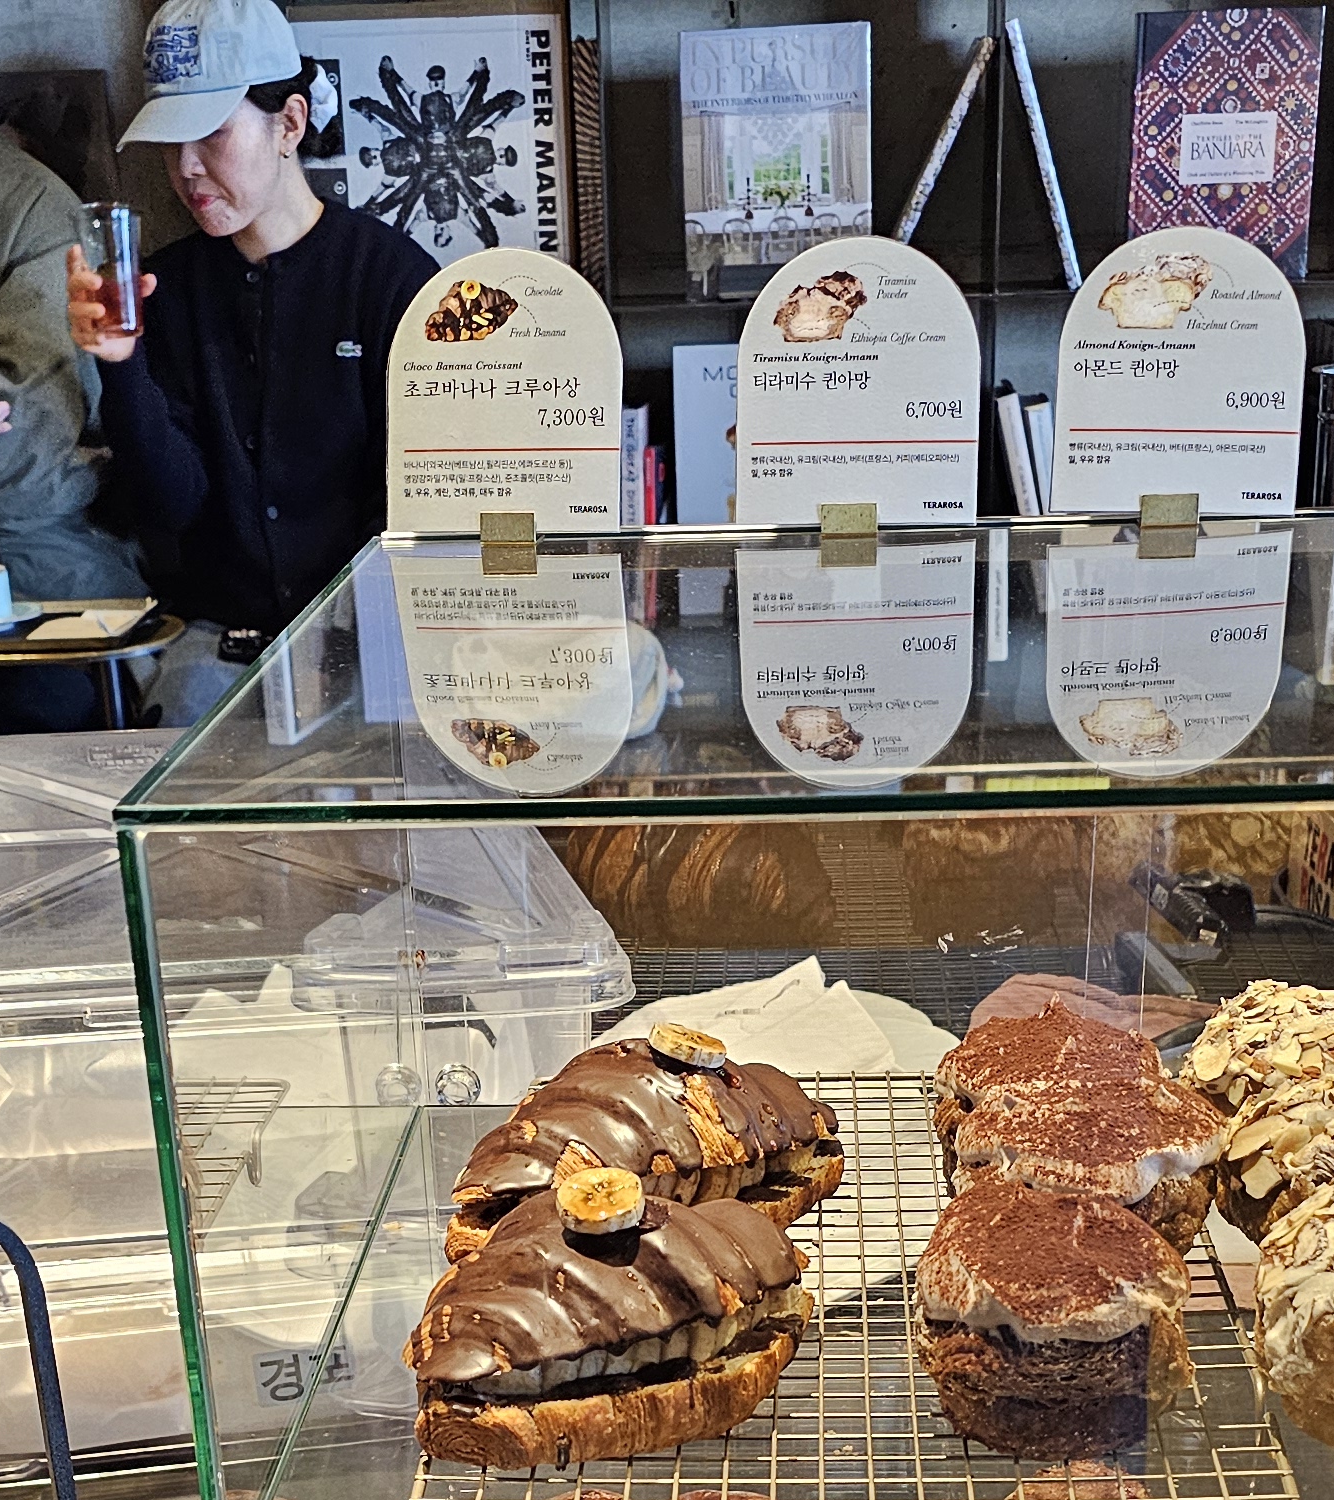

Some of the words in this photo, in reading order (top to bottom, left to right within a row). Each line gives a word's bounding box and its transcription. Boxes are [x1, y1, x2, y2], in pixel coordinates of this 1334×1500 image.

[530, 30, 554, 128] PETER
[690, 67, 729, 96] OF
[740, 60, 859, 93] BEAUTY
[1191, 141, 1265, 160] BANJARA
[877, 276, 917, 286] Tiramisu
[524, 286, 564, 296] Chocolate
[876, 289, 908, 299] Powder
[1210, 290, 1245, 300] Roasted
[1246, 290, 1282, 300] Almond
[1186, 319, 1227, 330] Hazelnut
[1230, 319, 1258, 330] Cream
[509, 327, 530, 338] Fresh
[533, 327, 566, 337] Banana
[850, 332, 887, 345] Ethiopia
[890, 332, 916, 345] Coffee
[918, 332, 946, 342] Cream
[1074, 340, 1116, 350] Almond
[1118, 340, 1196, 352] Kouign-Amann
[753, 353, 799, 363] Tiramisu
[801, 352, 879, 364] Kouign-Amann
[403, 361, 433, 371] Choco
[435, 361, 473, 370] Banana
[476, 361, 523, 370] Croissant
[1074, 359, 1124, 378] 아몬드
[1130, 359, 1179, 378] 퀸아망
[753, 372, 816, 391] 티라미수
[822, 371, 871, 390] 퀸아망
[403, 379, 497, 399] 초코바나나
[505, 377, 581, 398] 크루아상
[1226, 391, 1286, 410] 6,900원
[905, 399, 963, 419] 6,700원
[537, 407, 605, 428] 7,300원
[1241, 492, 1282, 501] TERAROSA
[569, 505, 608, 513] TERAROSA
[923, 501, 963, 509] TERAROSA
